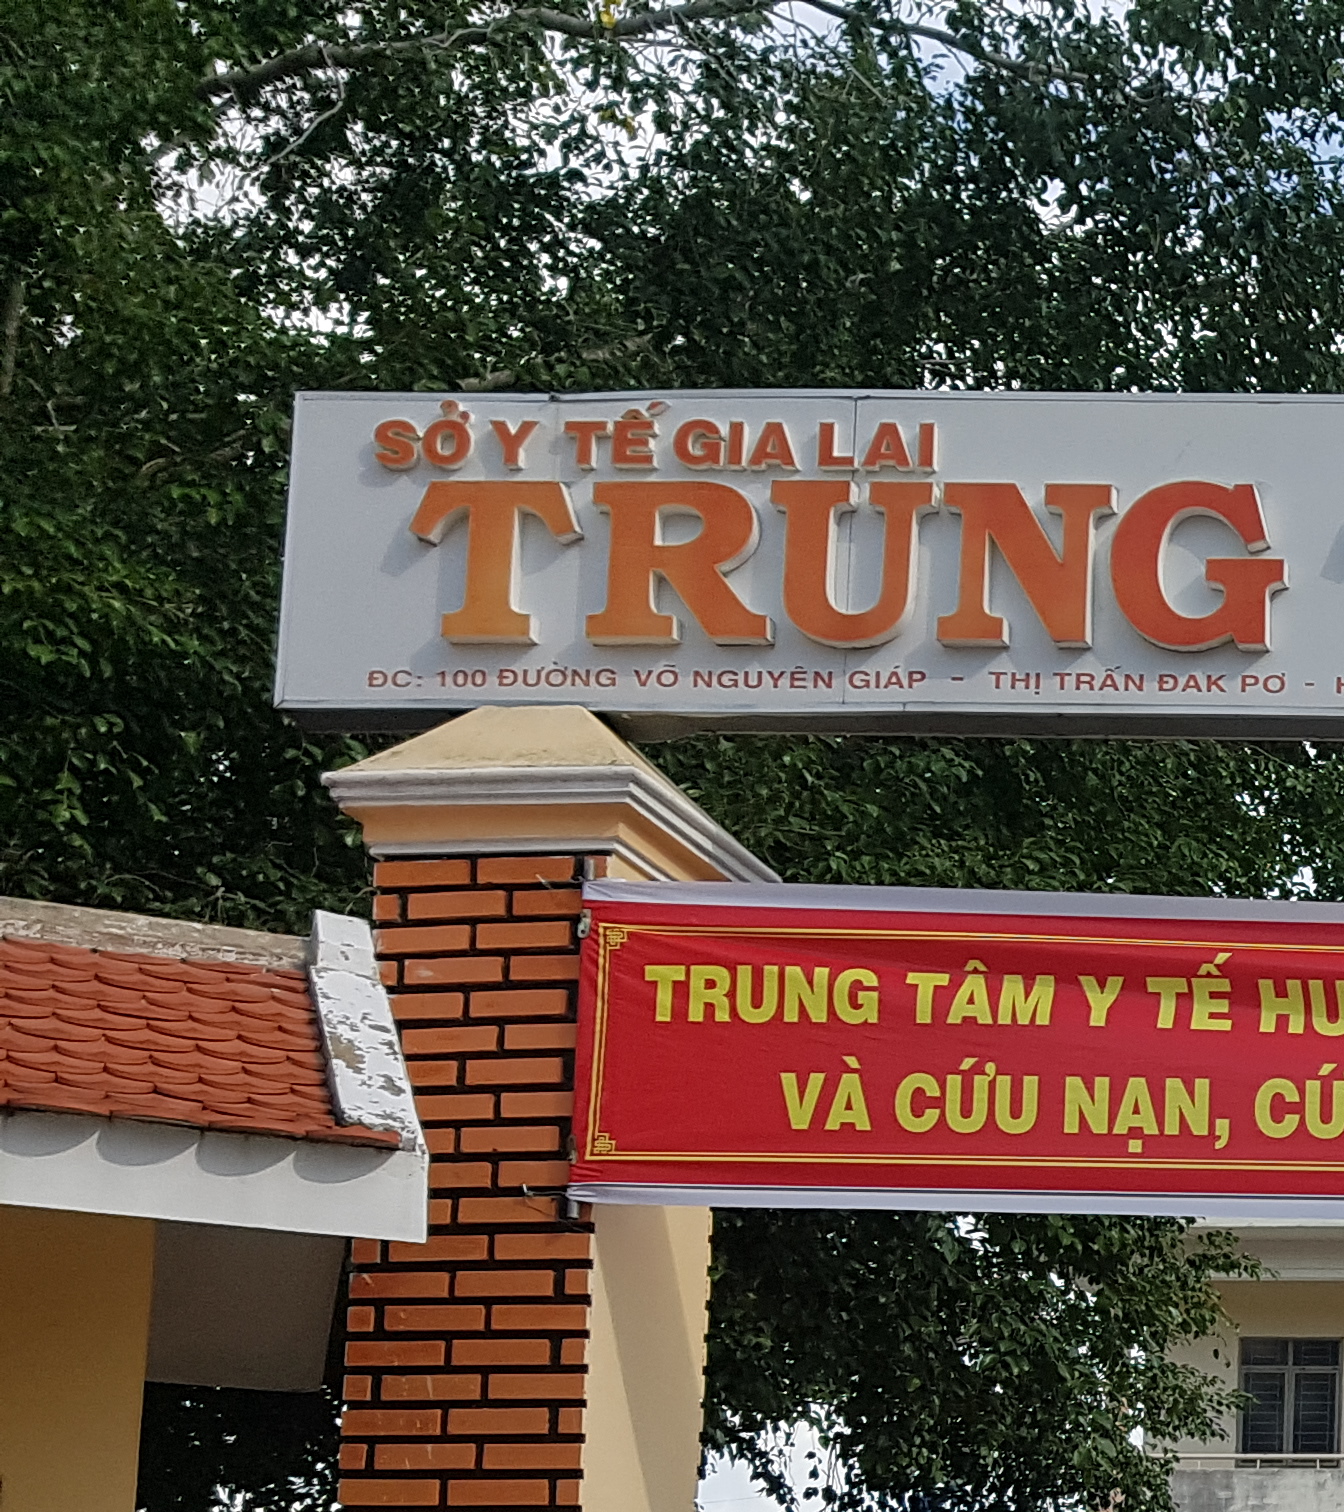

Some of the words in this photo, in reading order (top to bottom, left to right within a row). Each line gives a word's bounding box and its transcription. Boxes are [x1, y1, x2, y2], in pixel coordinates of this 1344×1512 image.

[373, 401, 475, 471] SỞ
[491, 420, 538, 470] Y
[565, 400, 672, 471] TẾ
[674, 420, 799, 472] GIA
[818, 420, 938, 473] LAI
[408, 478, 1289, 653] TRUNG
[367, 668, 425, 690] ĐC:
[436, 668, 488, 690] 100
[498, 659, 617, 691] ĐƯỜNG
[633, 661, 679, 691] VÕ
[692, 664, 834, 692] NGUYÊN
[848, 661, 927, 692] GIÁP
[991, 671, 1042, 698] THỊ
[1053, 661, 1145, 694] TRẤN
[1158, 671, 1226, 694] ĐAK
[1238, 669, 1288, 694] PƠ
[643, 963, 880, 1025] TRUNG
[904, 959, 1056, 1026] TÂM
[1078, 975, 1125, 1027] Y
[1146, 952, 1234, 1032] TẾ
[780, 1055, 872, 1132] VÀ
[894, 1056, 1040, 1133] CỨU
[1062, 1075, 1231, 1153] NẠN,
